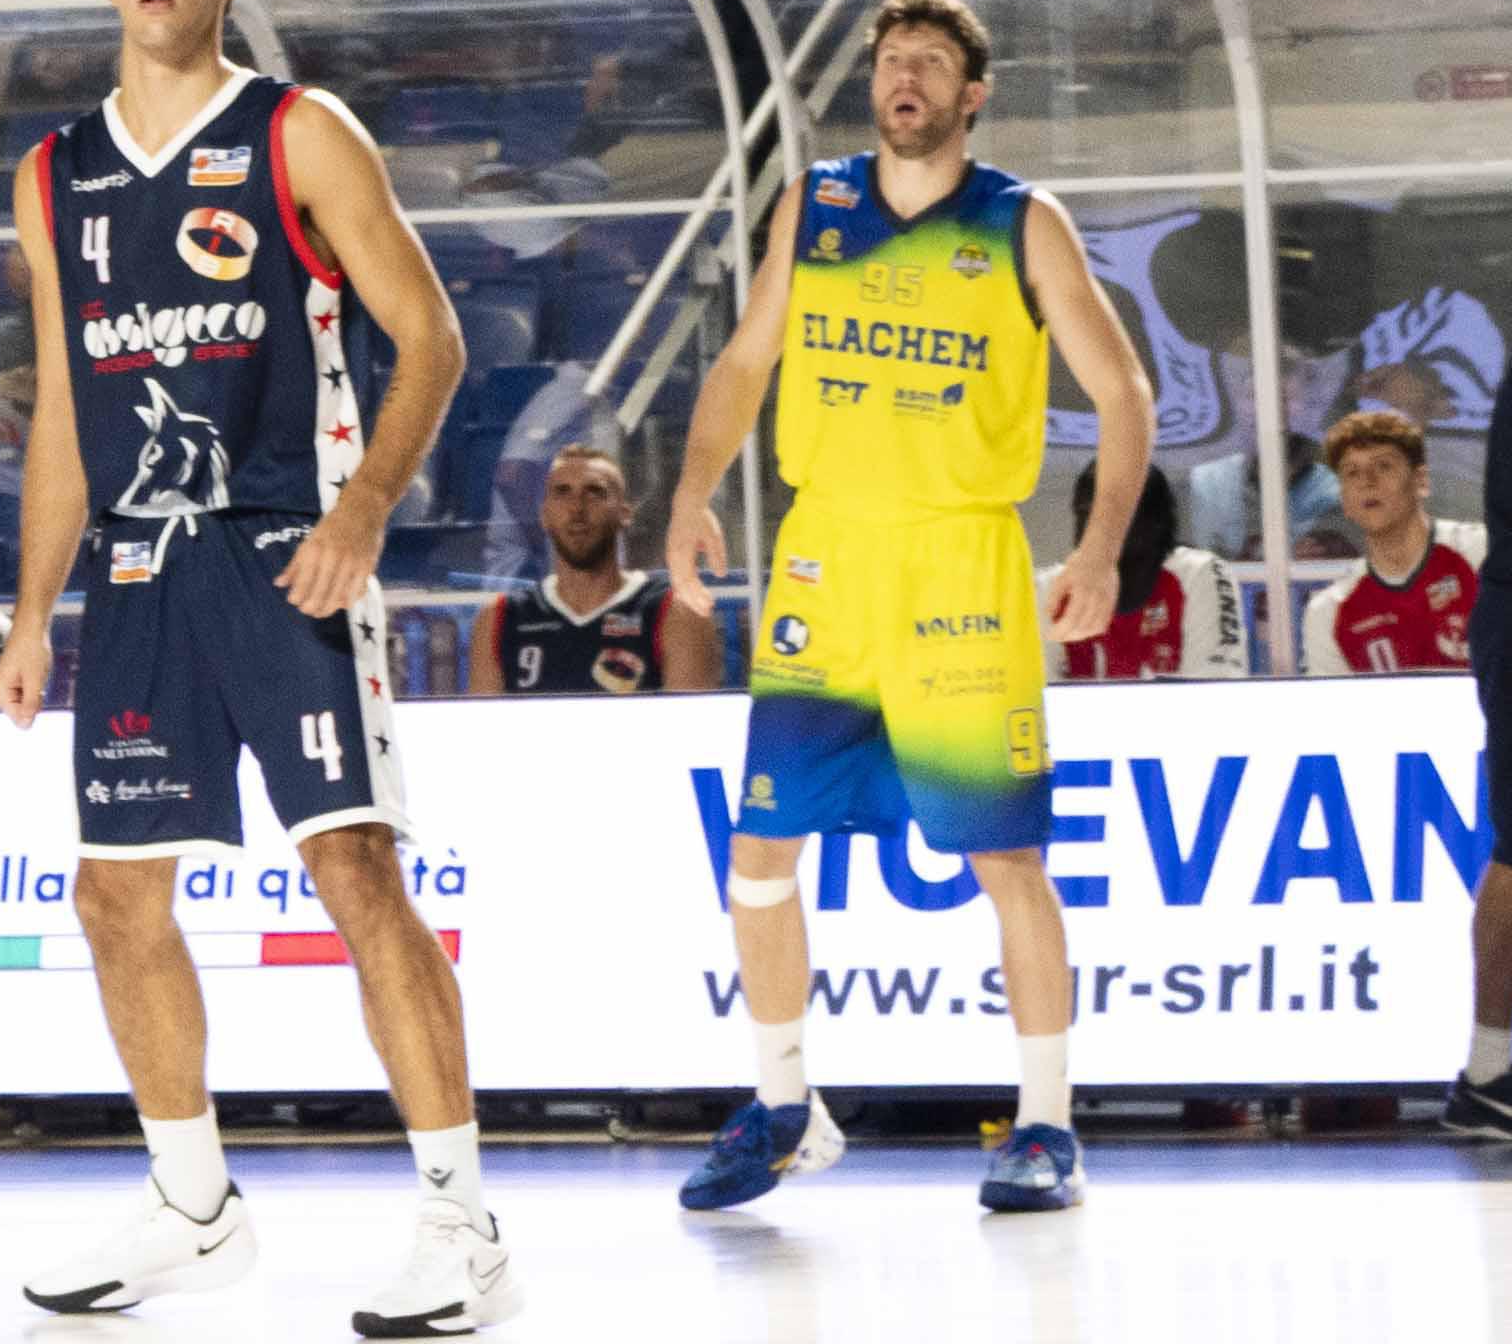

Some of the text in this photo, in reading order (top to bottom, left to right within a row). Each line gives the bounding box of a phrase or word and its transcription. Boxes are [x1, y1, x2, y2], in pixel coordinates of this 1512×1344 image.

[81, 215, 112, 284] 4
[860, 261, 925, 307] 95
[802, 312, 990, 372] ELACHEM
[517, 647, 543, 688] 9
[300, 710, 344, 782] 4
[703, 944, 1379, 1028] www.sr-srl.it
